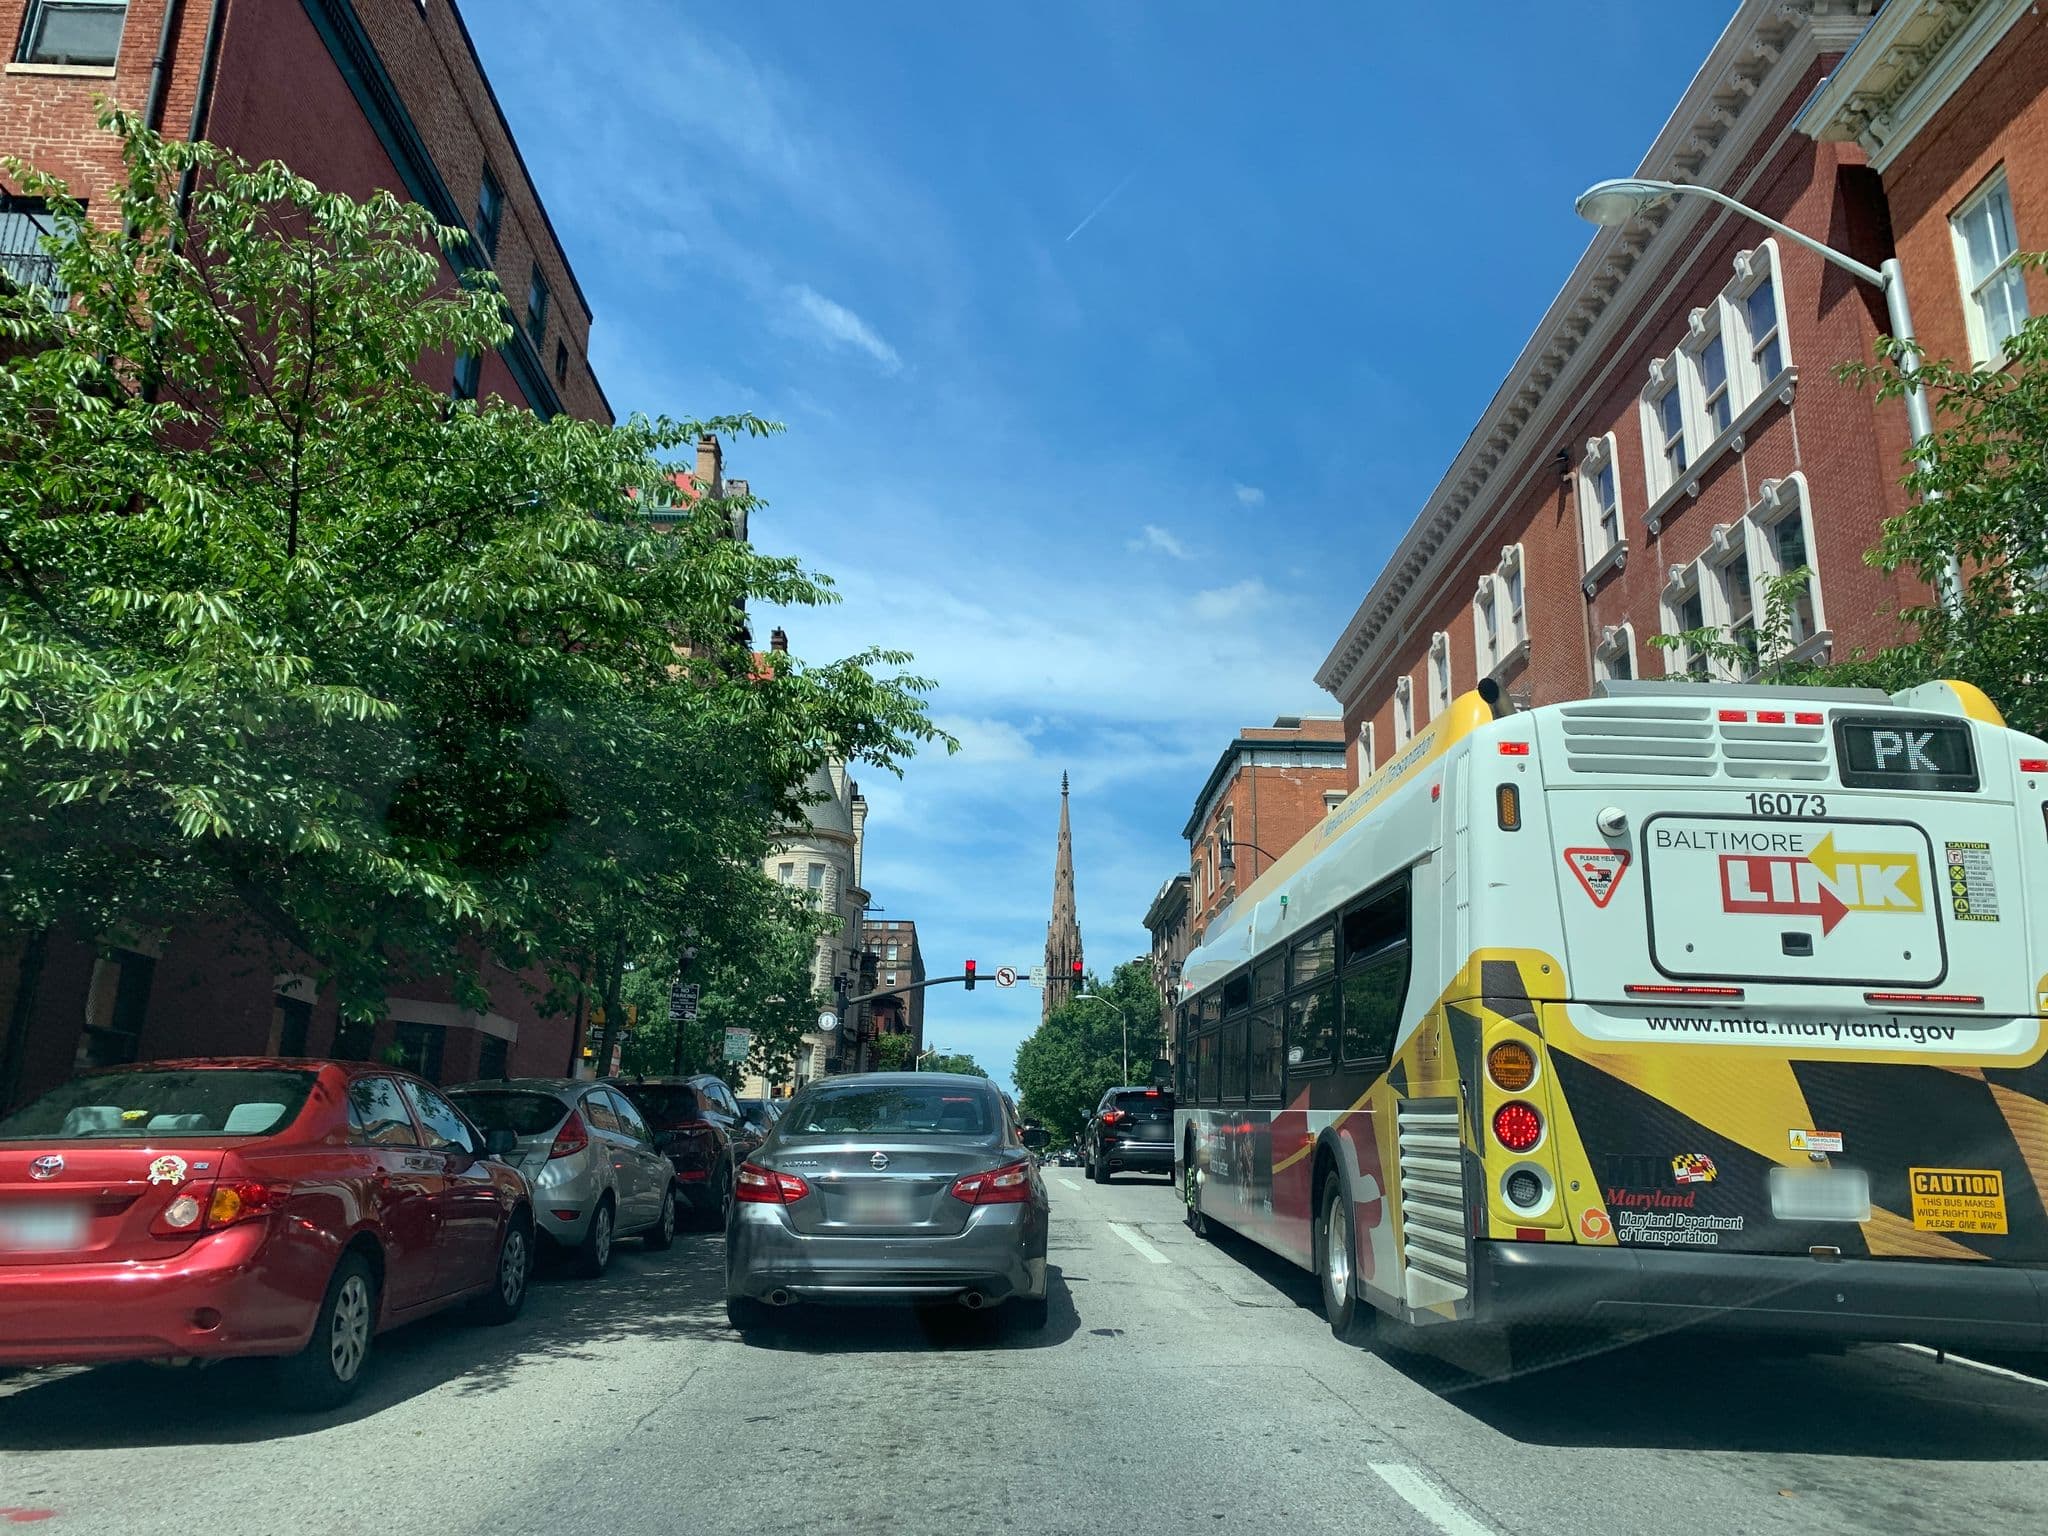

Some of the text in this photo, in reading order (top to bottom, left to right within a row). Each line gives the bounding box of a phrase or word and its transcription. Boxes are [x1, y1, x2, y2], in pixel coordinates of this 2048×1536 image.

[1873, 731, 1940, 770] PK
[1745, 793, 1827, 816] 16073
[1656, 829, 1804, 852] BALTIMORE
[1726, 859, 1918, 907] LINK
[1957, 913, 1997, 921] CAUTION
[1646, 1016, 1956, 1044] www.mta.maryland.gov
[782, 1160, 818, 1168] ALTIMA
[1915, 1175, 1998, 1194] CAUTION
[1605, 1187, 1696, 1211] Maryland
[1922, 1198, 1996, 1208] THIS BUS MAKES
[1620, 1212, 1744, 1231] Maryland Department
[1918, 1209, 2003, 1220] WIDE RIGHT TURNS
[1926, 1220, 1998, 1230] PLEASE GIVE WAY
[1619, 1228, 1719, 1246] of Transportation
